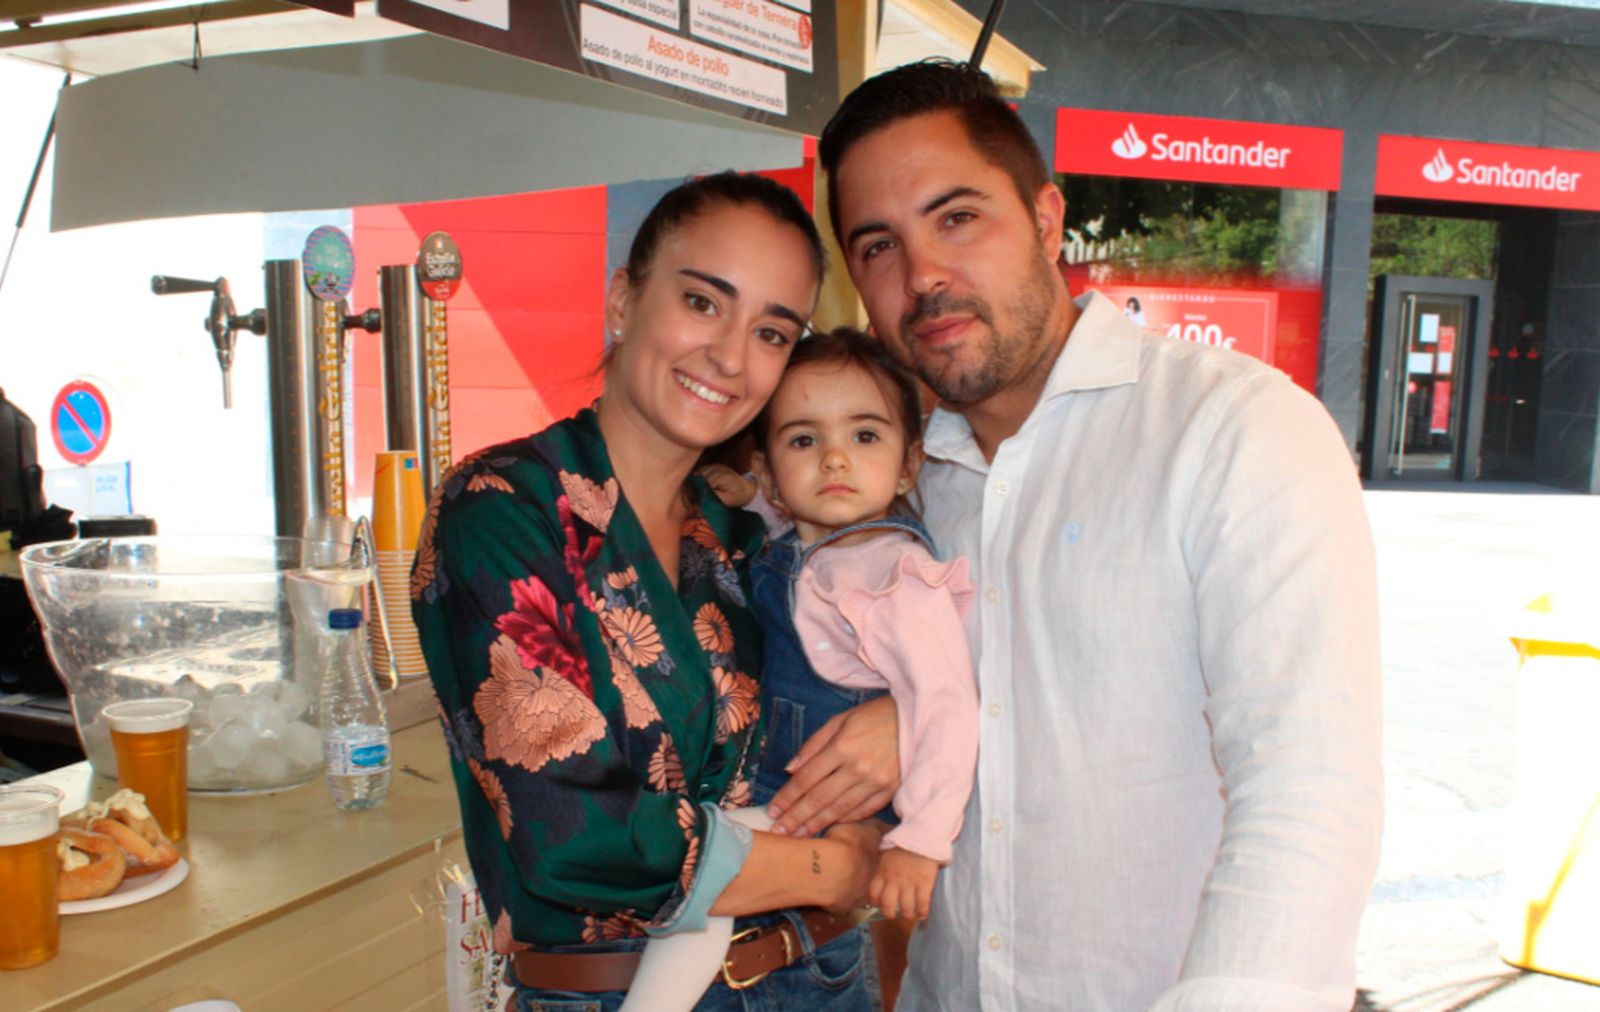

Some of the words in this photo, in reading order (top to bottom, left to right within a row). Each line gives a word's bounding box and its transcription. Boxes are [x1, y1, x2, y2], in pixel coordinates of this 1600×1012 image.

[584, 38, 610, 57] Asado
[612, 48, 622, 61] de
[624, 53, 644, 68] pollo
[654, 62, 679, 79] yogurt
[648, 35, 684, 61] Asado
[687, 50, 700, 67] de
[703, 57, 729, 76] pollo
[1151, 133, 1291, 169] Santander
[1456, 158, 1582, 192] Santander
